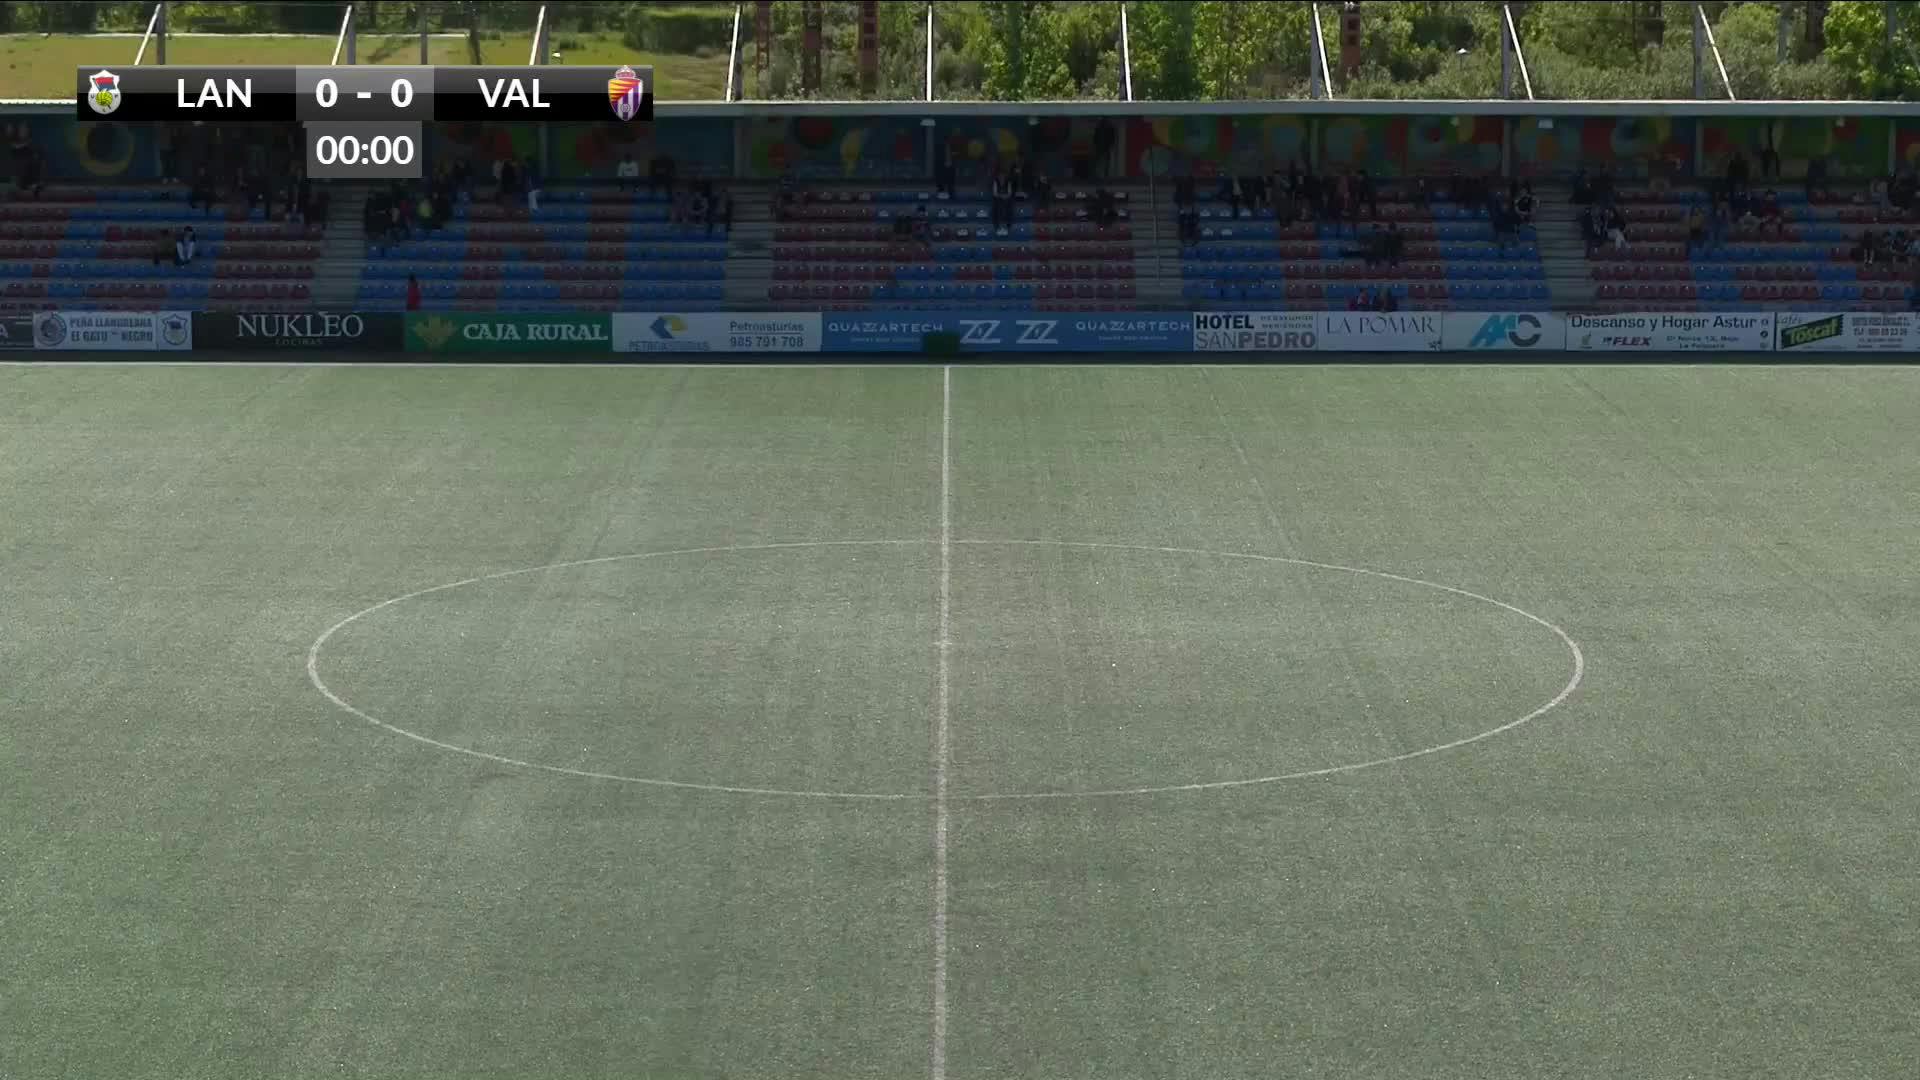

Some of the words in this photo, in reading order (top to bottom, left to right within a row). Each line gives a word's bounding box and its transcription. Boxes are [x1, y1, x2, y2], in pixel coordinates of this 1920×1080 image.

[237, 312, 364, 337] NUKLEO
[1195, 315, 1255, 329] HOTEL
[1326, 317, 1351, 334] LA
[1359, 316, 1435, 334] POMAR
[1571, 316, 1646, 329] Descanso
[1649, 318, 1658, 332] y
[1662, 316, 1709, 331] Hogar
[1713, 315, 1758, 329] Astur
[463, 324, 521, 341] CAJA
[527, 324, 609, 341] RURAL
[1612, 336, 1651, 346] FLEX
[756, 336, 777, 348] 791
[782, 336, 804, 348] 708
